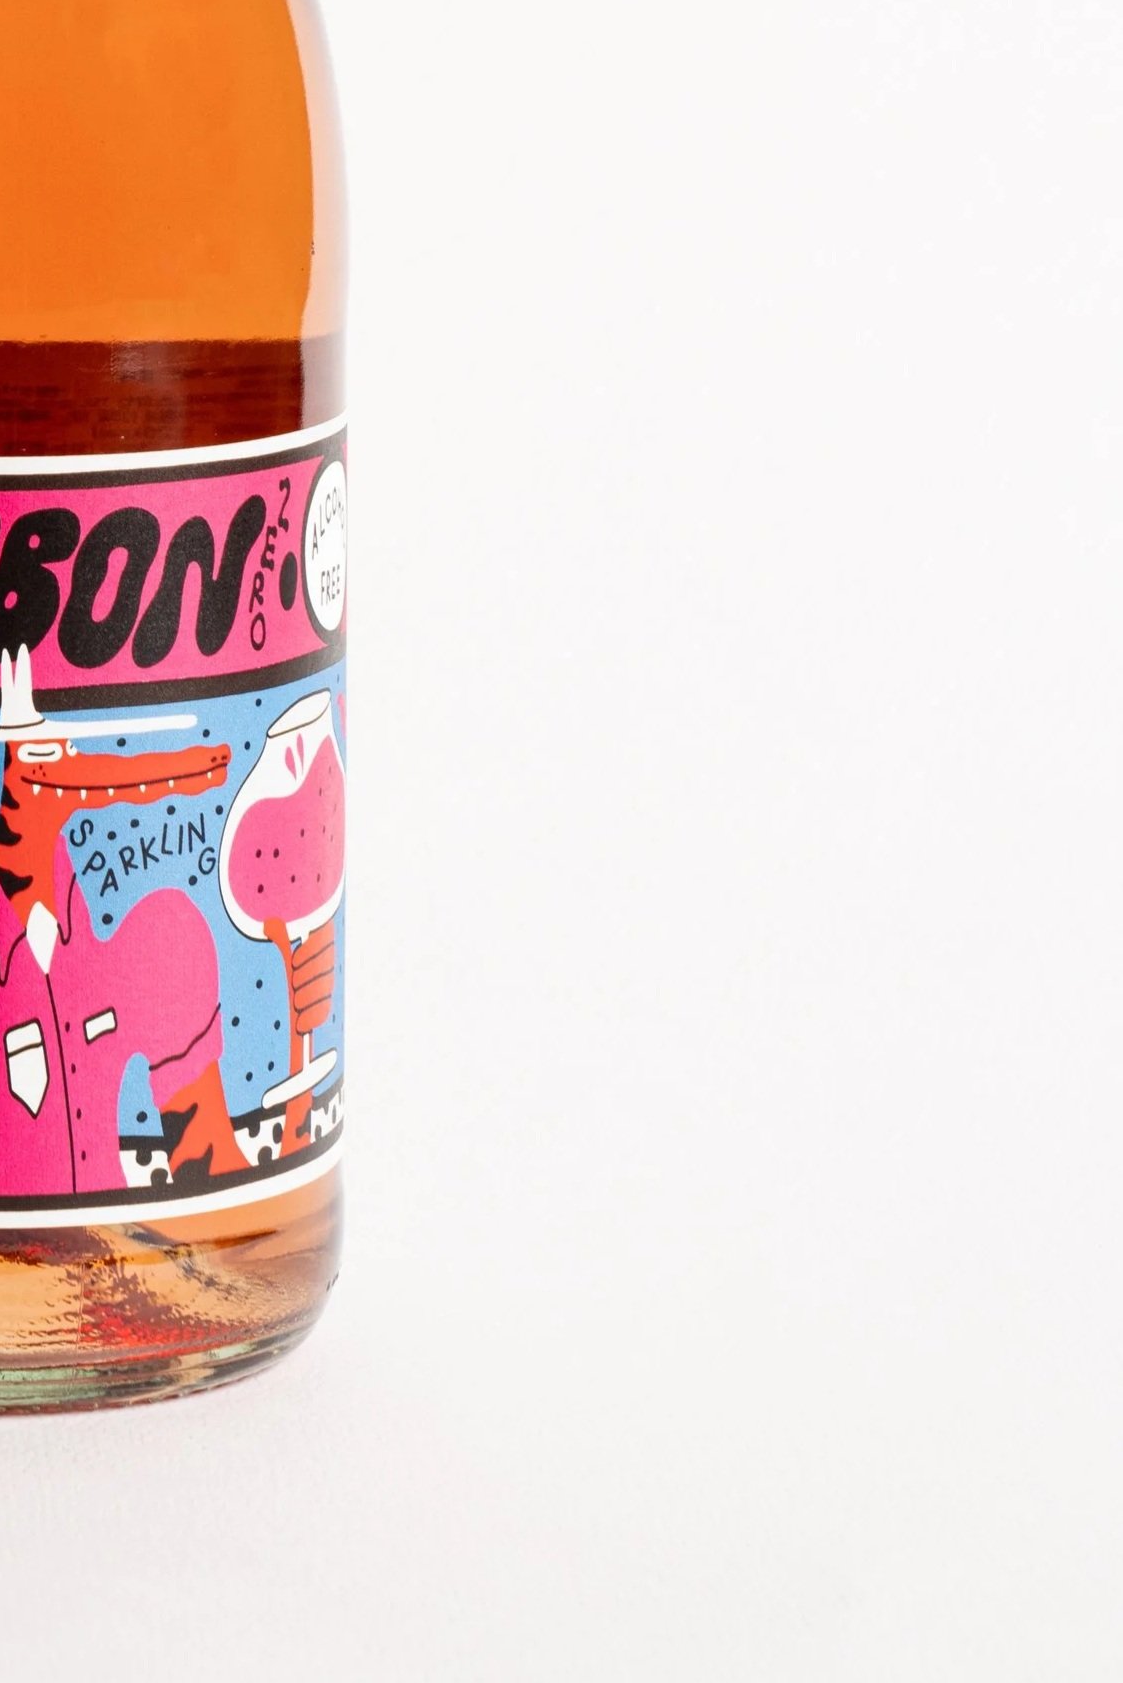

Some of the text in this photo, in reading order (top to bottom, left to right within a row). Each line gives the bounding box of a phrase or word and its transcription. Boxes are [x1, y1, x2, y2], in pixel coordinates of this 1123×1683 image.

[249, 477, 291, 652] ZERO
[320, 563, 340, 606] FREE
[69, 813, 217, 898] SPARKLING
